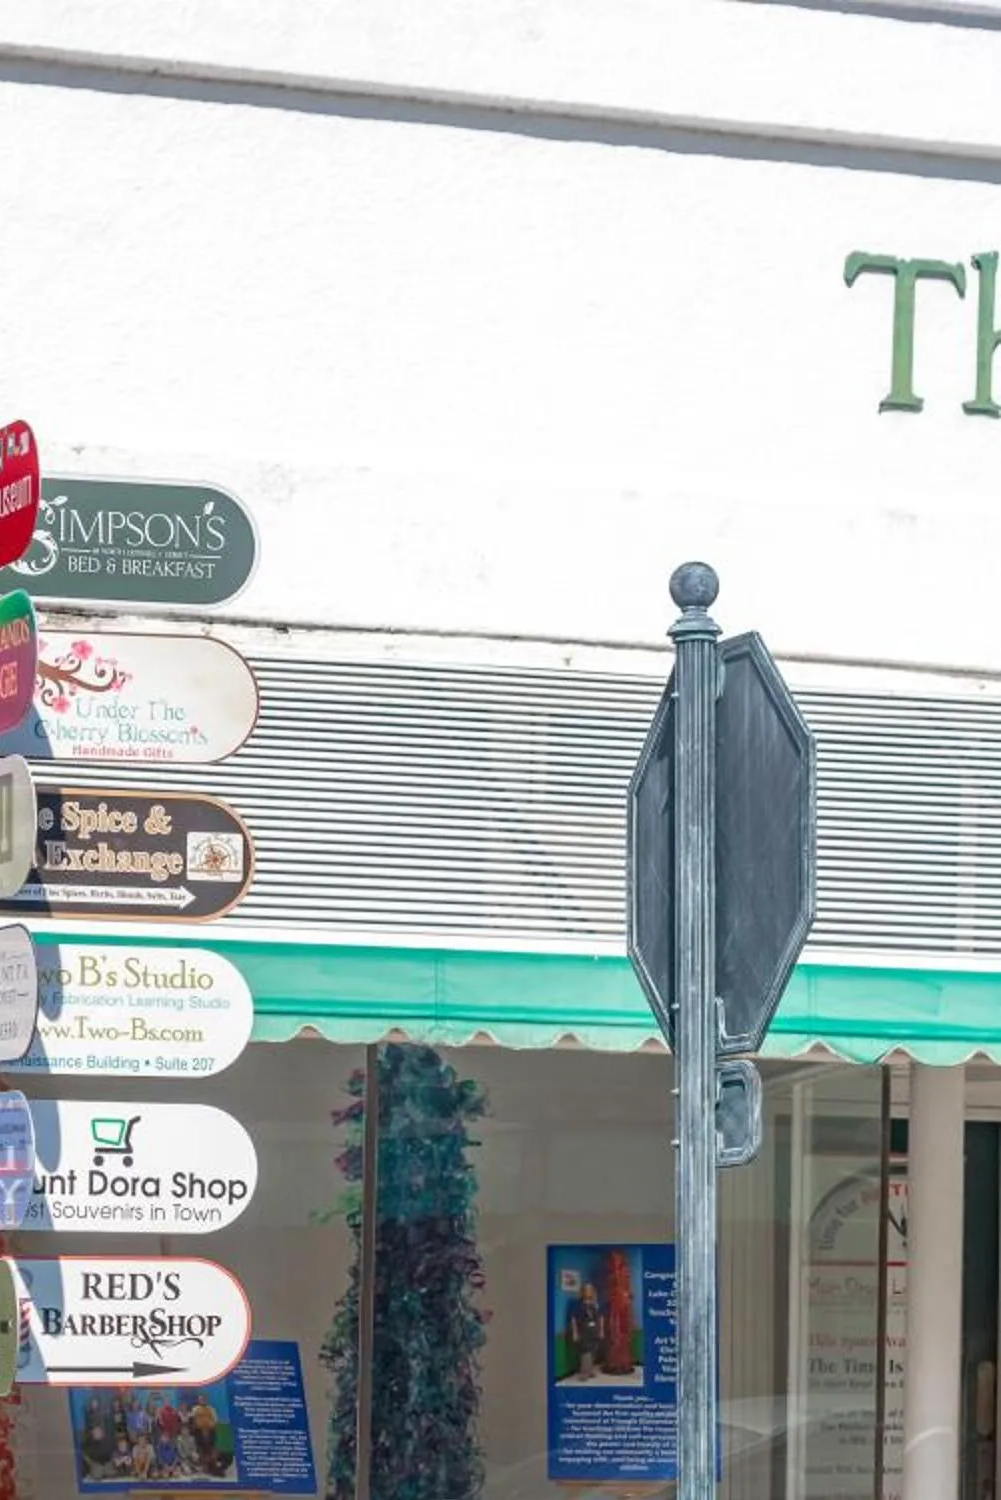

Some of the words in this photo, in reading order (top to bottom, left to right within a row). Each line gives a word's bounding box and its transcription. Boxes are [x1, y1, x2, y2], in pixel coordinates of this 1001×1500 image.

[68, 556, 99, 574] BED
[106, 558, 117, 575] &
[122, 559, 216, 580] BREAKFAST
[75, 697, 138, 719] Under
[149, 700, 186, 721] The
[34, 719, 109, 745] Cherry
[72, 746, 139, 758] Handmade
[143, 746, 174, 759] Gifts
[61, 801, 138, 839] Spice
[144, 804, 172, 835] &
[43, 840, 184, 881] Exchange
[38, 967, 73, 985] wo
[79, 954, 118, 988] B's
[124, 956, 214, 990] Studio
[53, 991, 125, 1008] Fabrication
[128, 993, 185, 1012] Learning
[188, 994, 231, 1010] Studio
[38, 1015, 204, 1043] ww.Two-Bs.com
[86, 1054, 140, 1072] Building
[155, 1056, 188, 1071] Suite
[192, 1057, 216, 1071] 207
[32, 1169, 77, 1196] unt
[89, 1169, 160, 1197] Dora
[171, 1171, 247, 1205] Shop
[52, 1201, 144, 1221] Souvenirs
[150, 1203, 166, 1221] in
[172, 1203, 222, 1222] Town
[82, 1271, 182, 1301] RED'S
[843, 1357, 875, 1374] Tim
